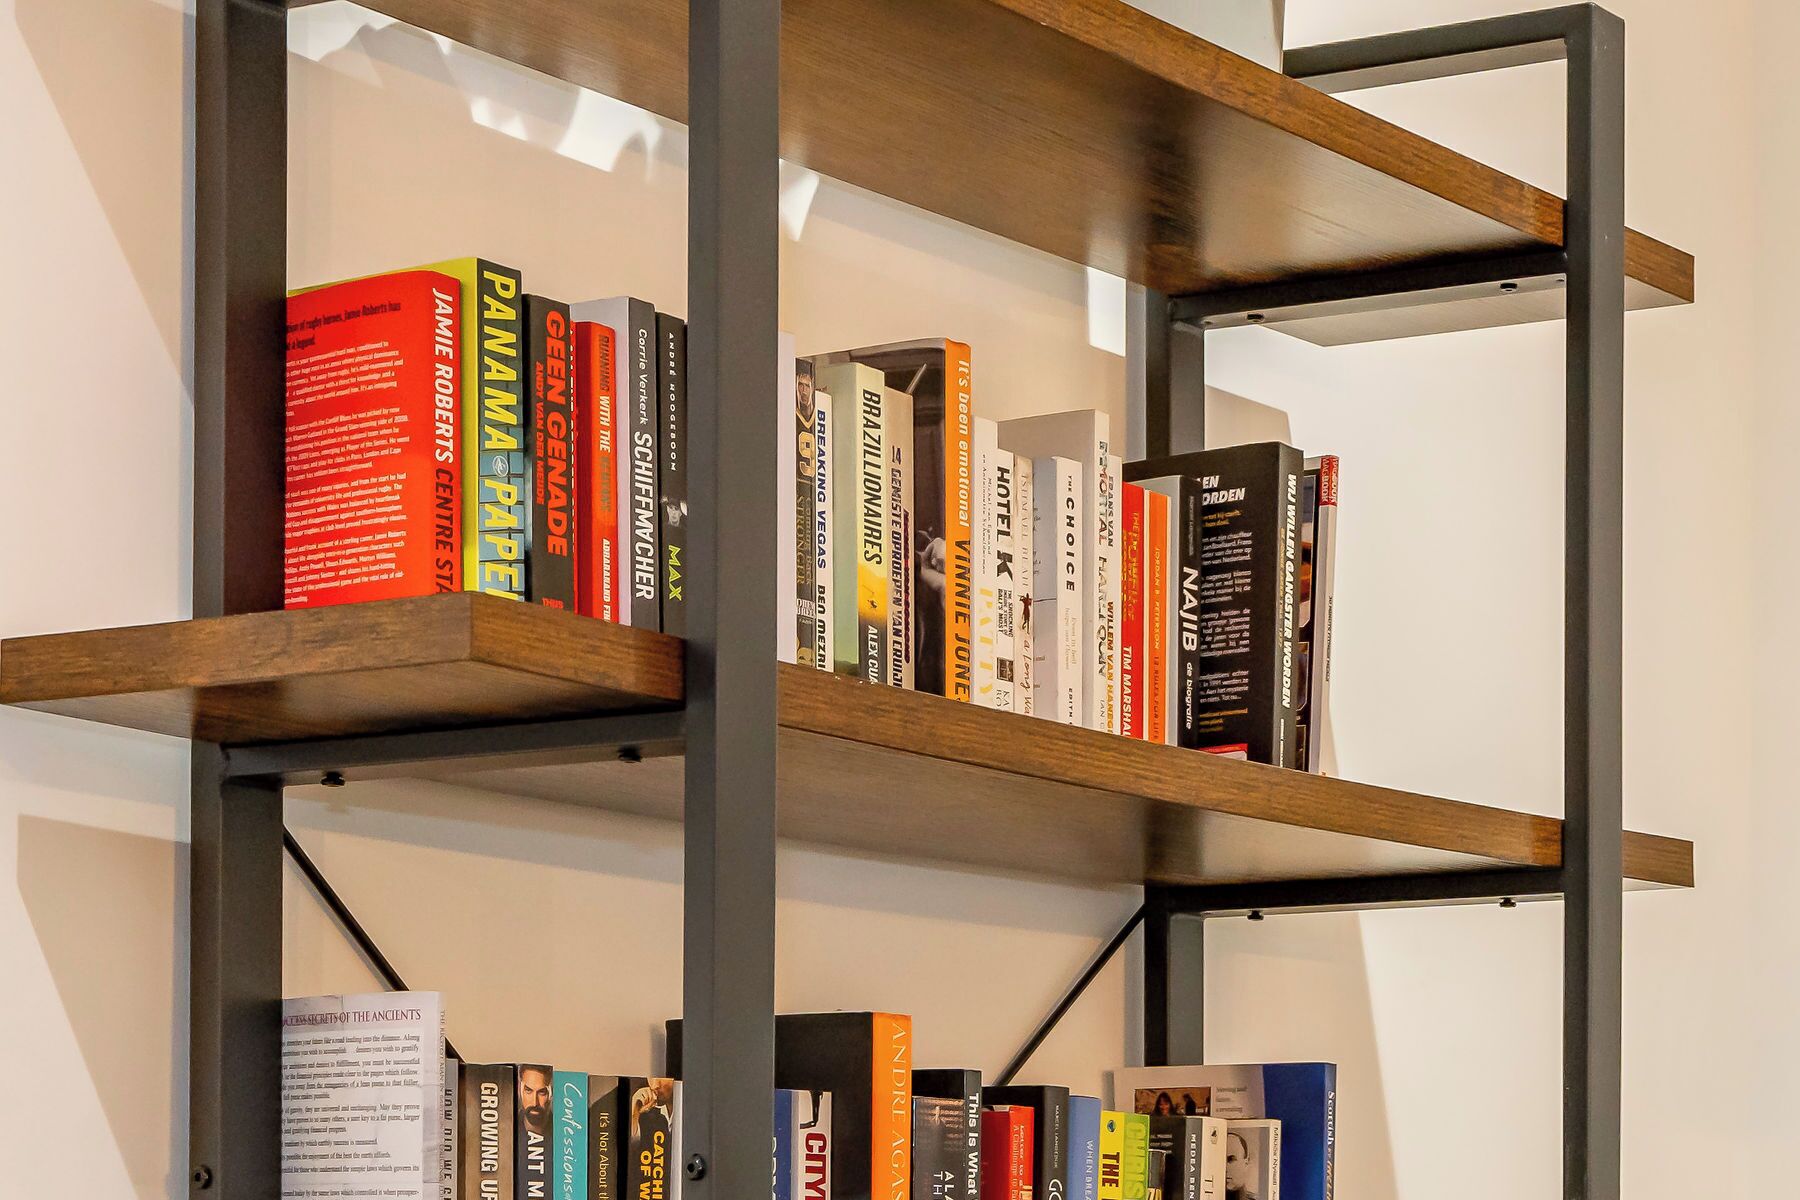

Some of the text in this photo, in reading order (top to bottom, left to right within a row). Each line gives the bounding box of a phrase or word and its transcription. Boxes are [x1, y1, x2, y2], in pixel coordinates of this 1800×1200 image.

[482, 270, 518, 450] PANAMA
[638, 328, 648, 425] Corrie Verkerk
[432, 287, 455, 562] JAMIE ROBERTS CENTRE
[536, 402, 545, 457] VAN DER
[546, 310, 568, 557] GEEN GENADE
[600, 395, 611, 426] WITH
[600, 427, 611, 453] THE
[668, 383, 682, 601] HOOGEBOOM MAX
[816, 408, 826, 569] BREAKING VEGAS
[862, 389, 883, 565] BRAZILLIONAIRES
[954, 440, 971, 624] emotional VINNIE
[996, 465, 1013, 582] HOTEL K
[1065, 497, 1076, 592] CHOICE
[1179, 566, 1199, 652] NAJIB
[1283, 561, 1295, 639] GANGSTER
[867, 625, 879, 656] ALEX
[1122, 645, 1132, 670] TIM
[1282, 640, 1293, 709] WORDEN
[340, 1008, 422, 1023] OF THE ANCIENTS
[892, 1022, 907, 1122] ANDRE
[480, 1082, 499, 1172] GROWING
[968, 1093, 979, 1128] This
[527, 1131, 545, 1174] ANT
[599, 1132, 609, 1148] Not
[640, 1151, 652, 1176] OF
[1011, 1134, 1019, 1176] Challenge
[1086, 1140, 1094, 1174] WHEN
[1189, 1133, 1197, 1173] MEDEA
[598, 1153, 609, 1183] About
[967, 1151, 979, 1195] What
[1102, 1152, 1121, 1188] THE
